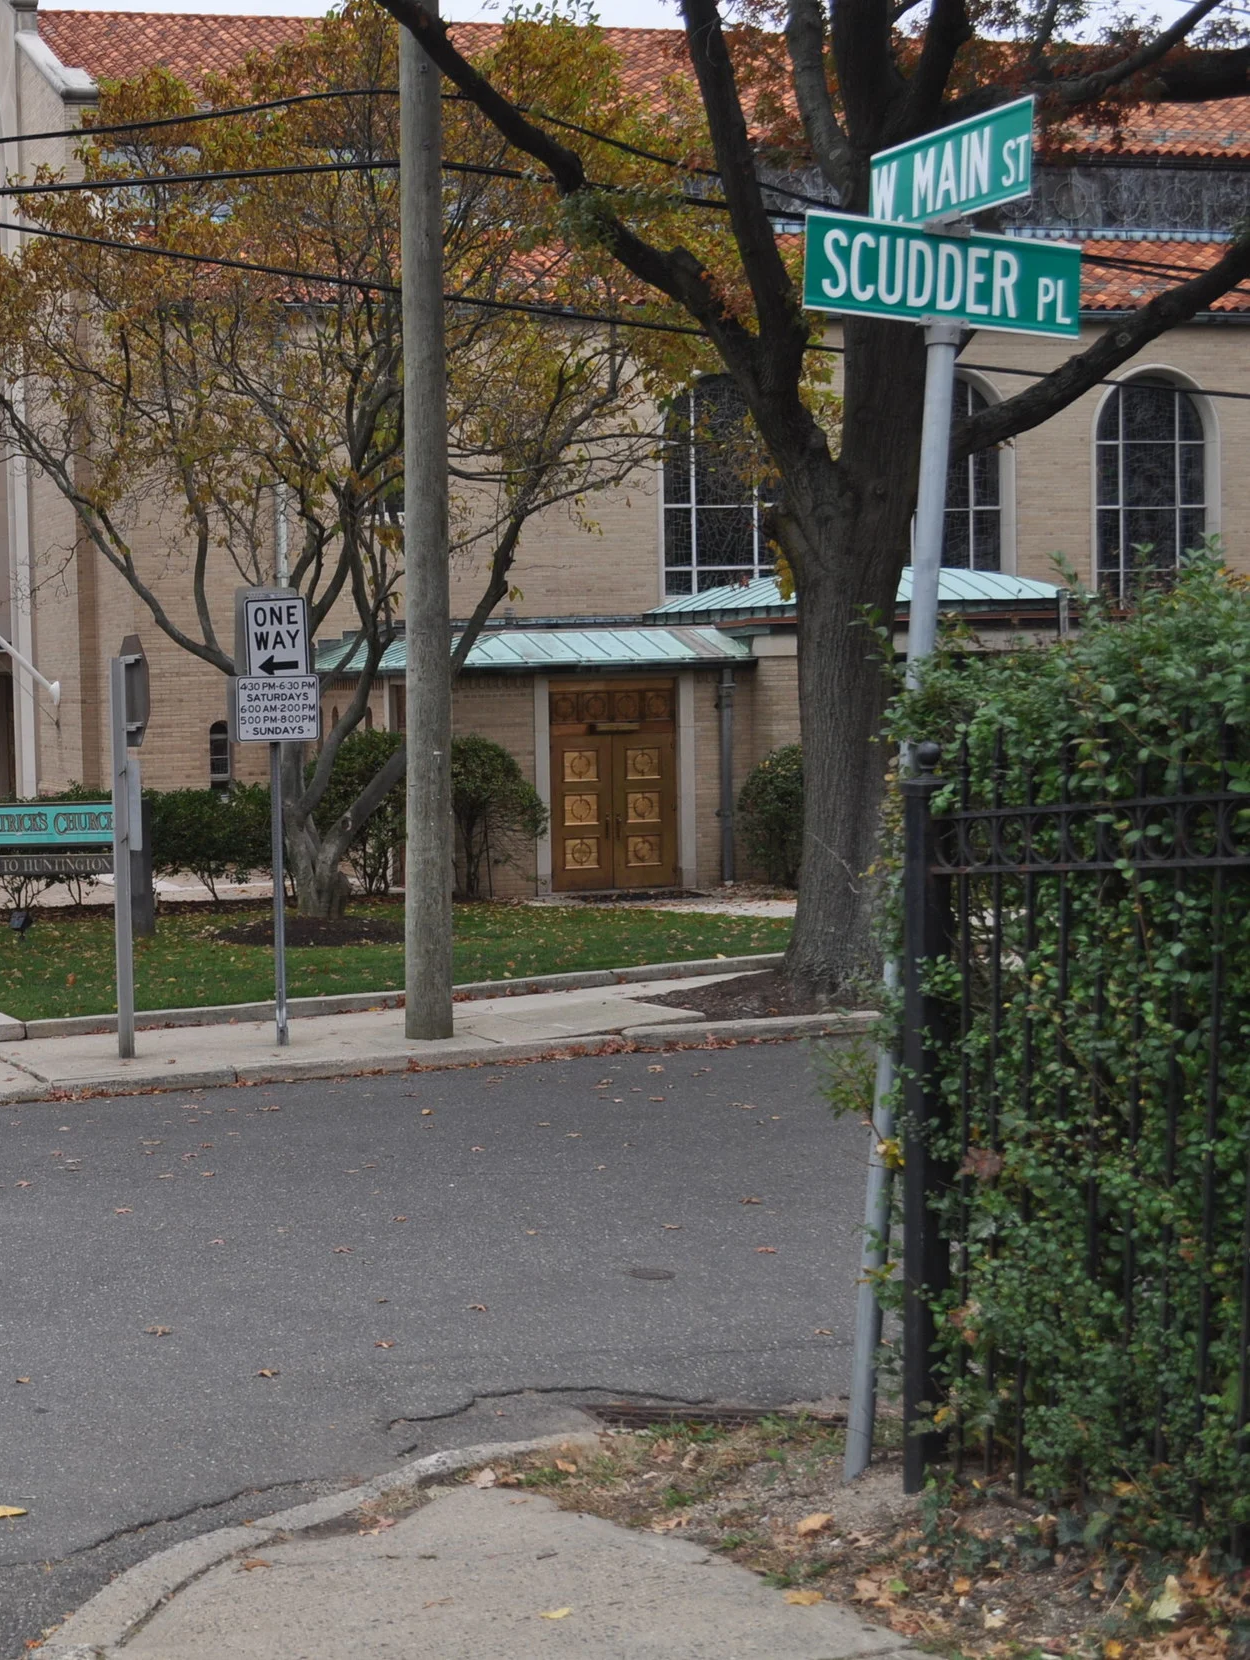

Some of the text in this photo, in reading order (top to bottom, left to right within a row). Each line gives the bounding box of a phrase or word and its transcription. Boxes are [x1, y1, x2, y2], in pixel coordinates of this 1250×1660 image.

[912, 126, 992, 218] MAIN
[1001, 134, 1029, 188] ST
[821, 229, 1072, 325] SCUDDER PL
[254, 605, 299, 627] ONE
[254, 629, 300, 651] WAY
[301, 681, 316, 691] PM
[247, 692, 310, 702] SATURDAYS
[302, 703, 316, 713] PM
[302, 714, 316, 724] PM
[252, 726, 305, 736] SUNDAYS
[3, 858, 19, 872] TO
[23, 856, 112, 872] HUNTINGTON
